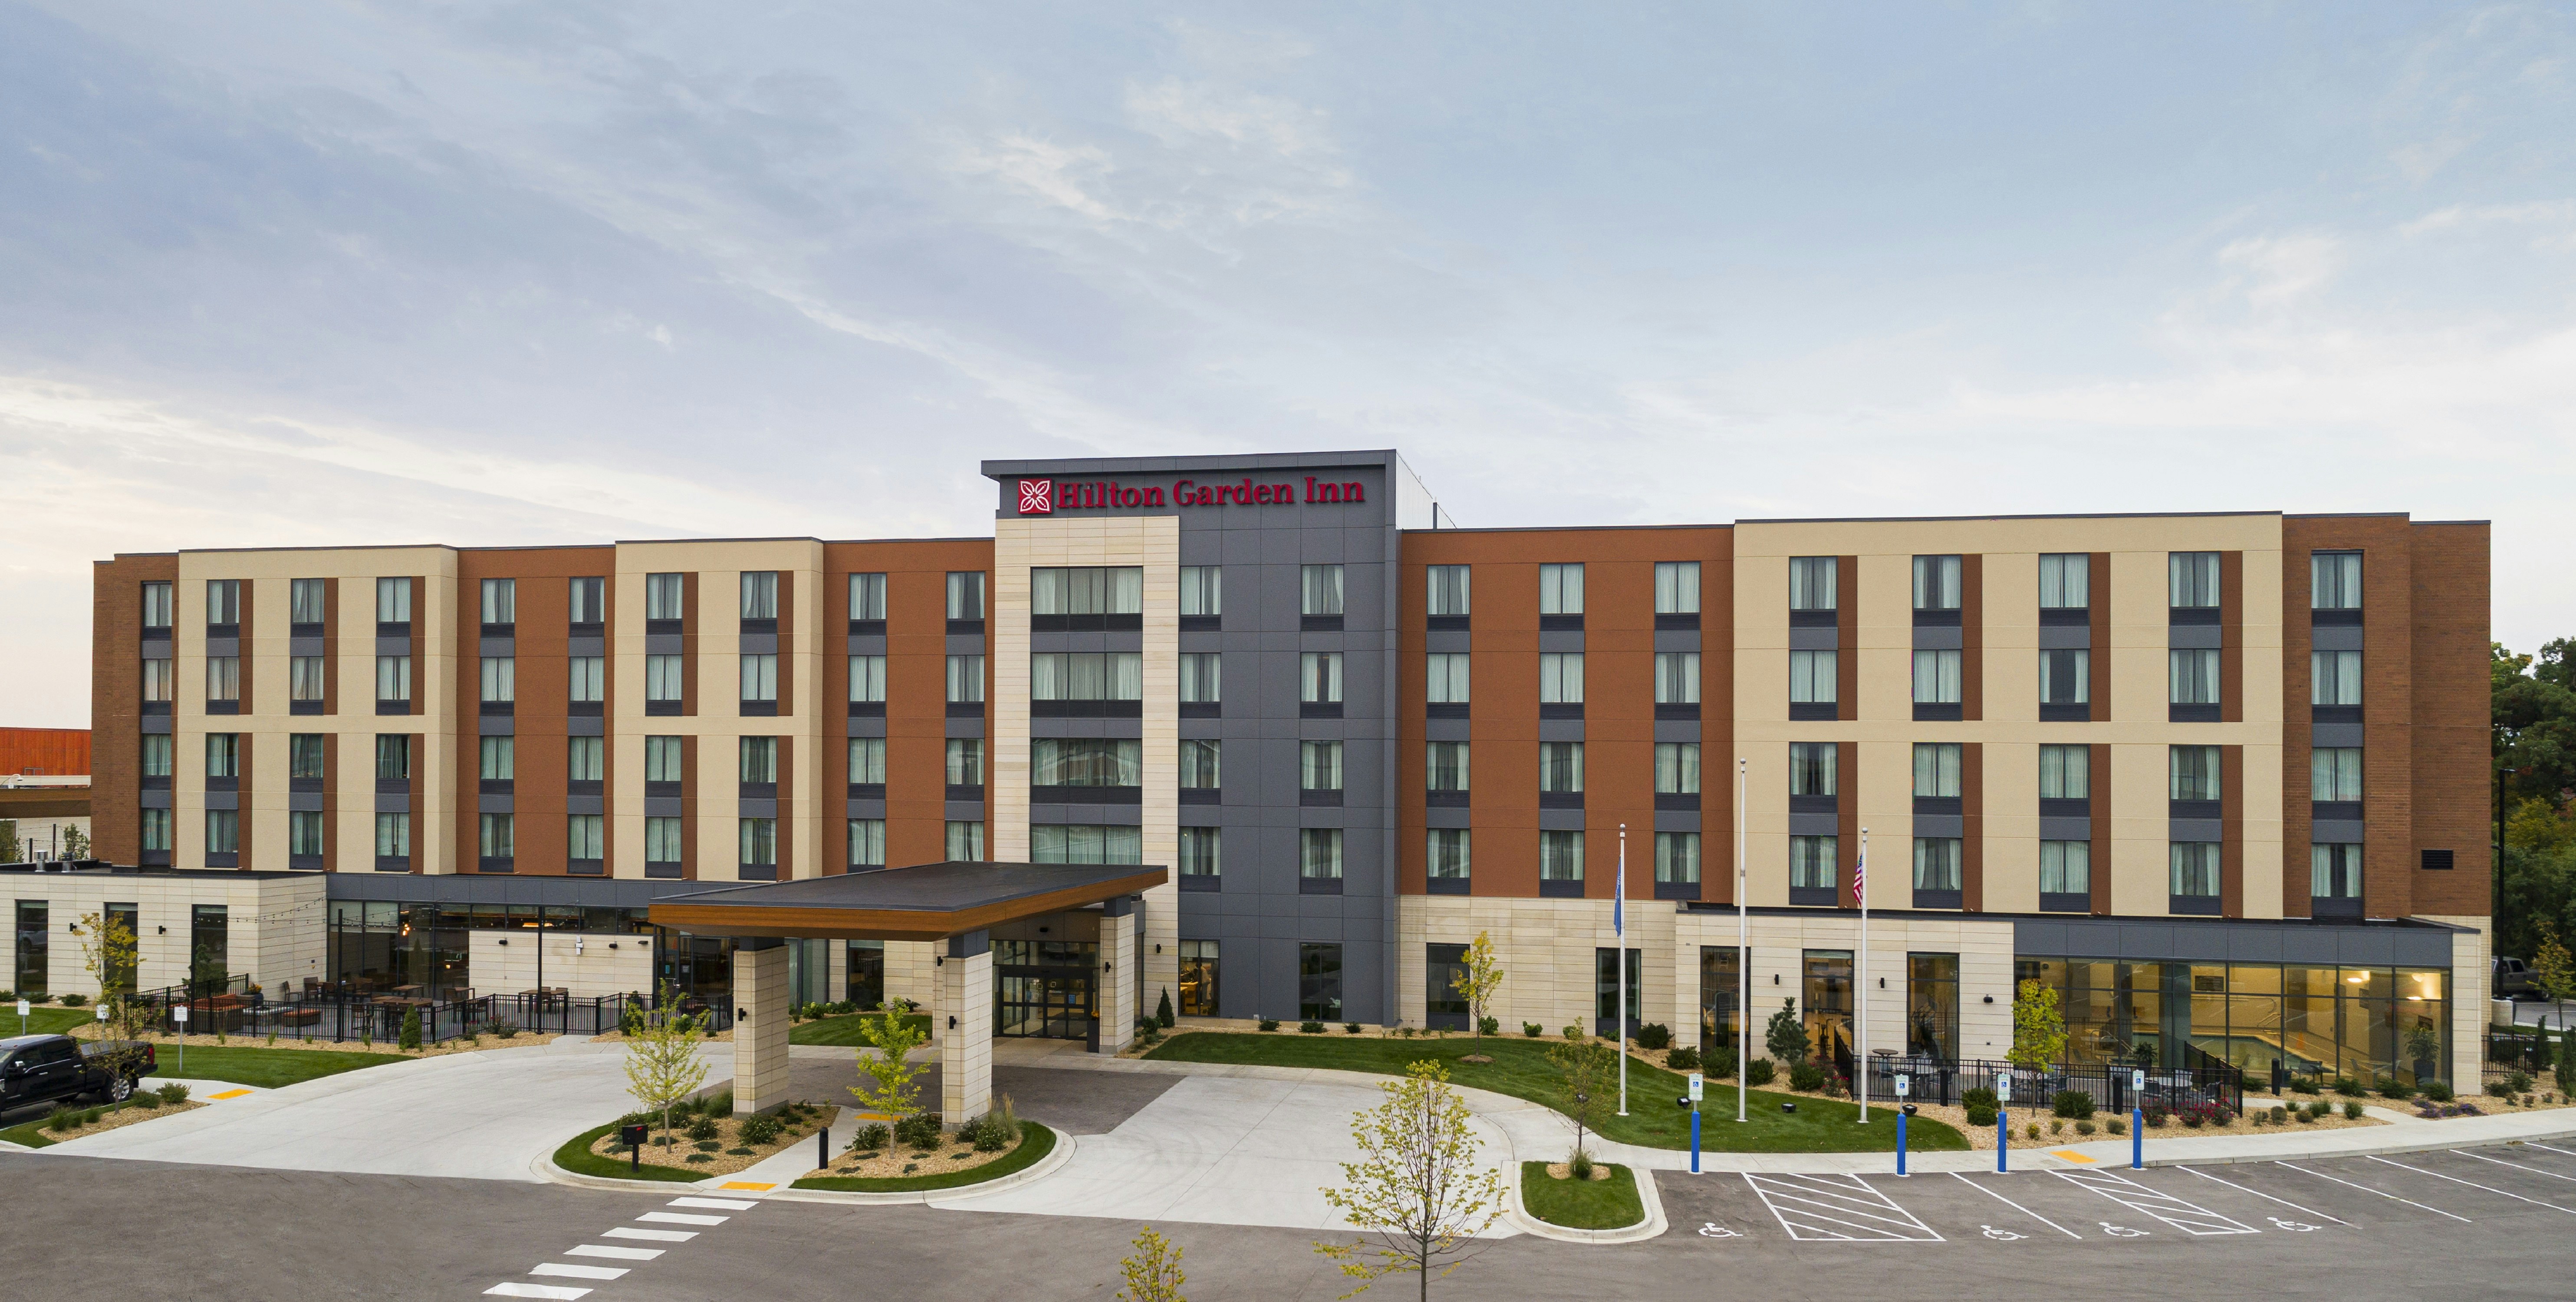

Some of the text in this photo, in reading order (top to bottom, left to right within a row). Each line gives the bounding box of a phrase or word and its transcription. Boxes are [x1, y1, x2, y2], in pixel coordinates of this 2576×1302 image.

[1056, 476, 1365, 508] Hilton Garden Inn
